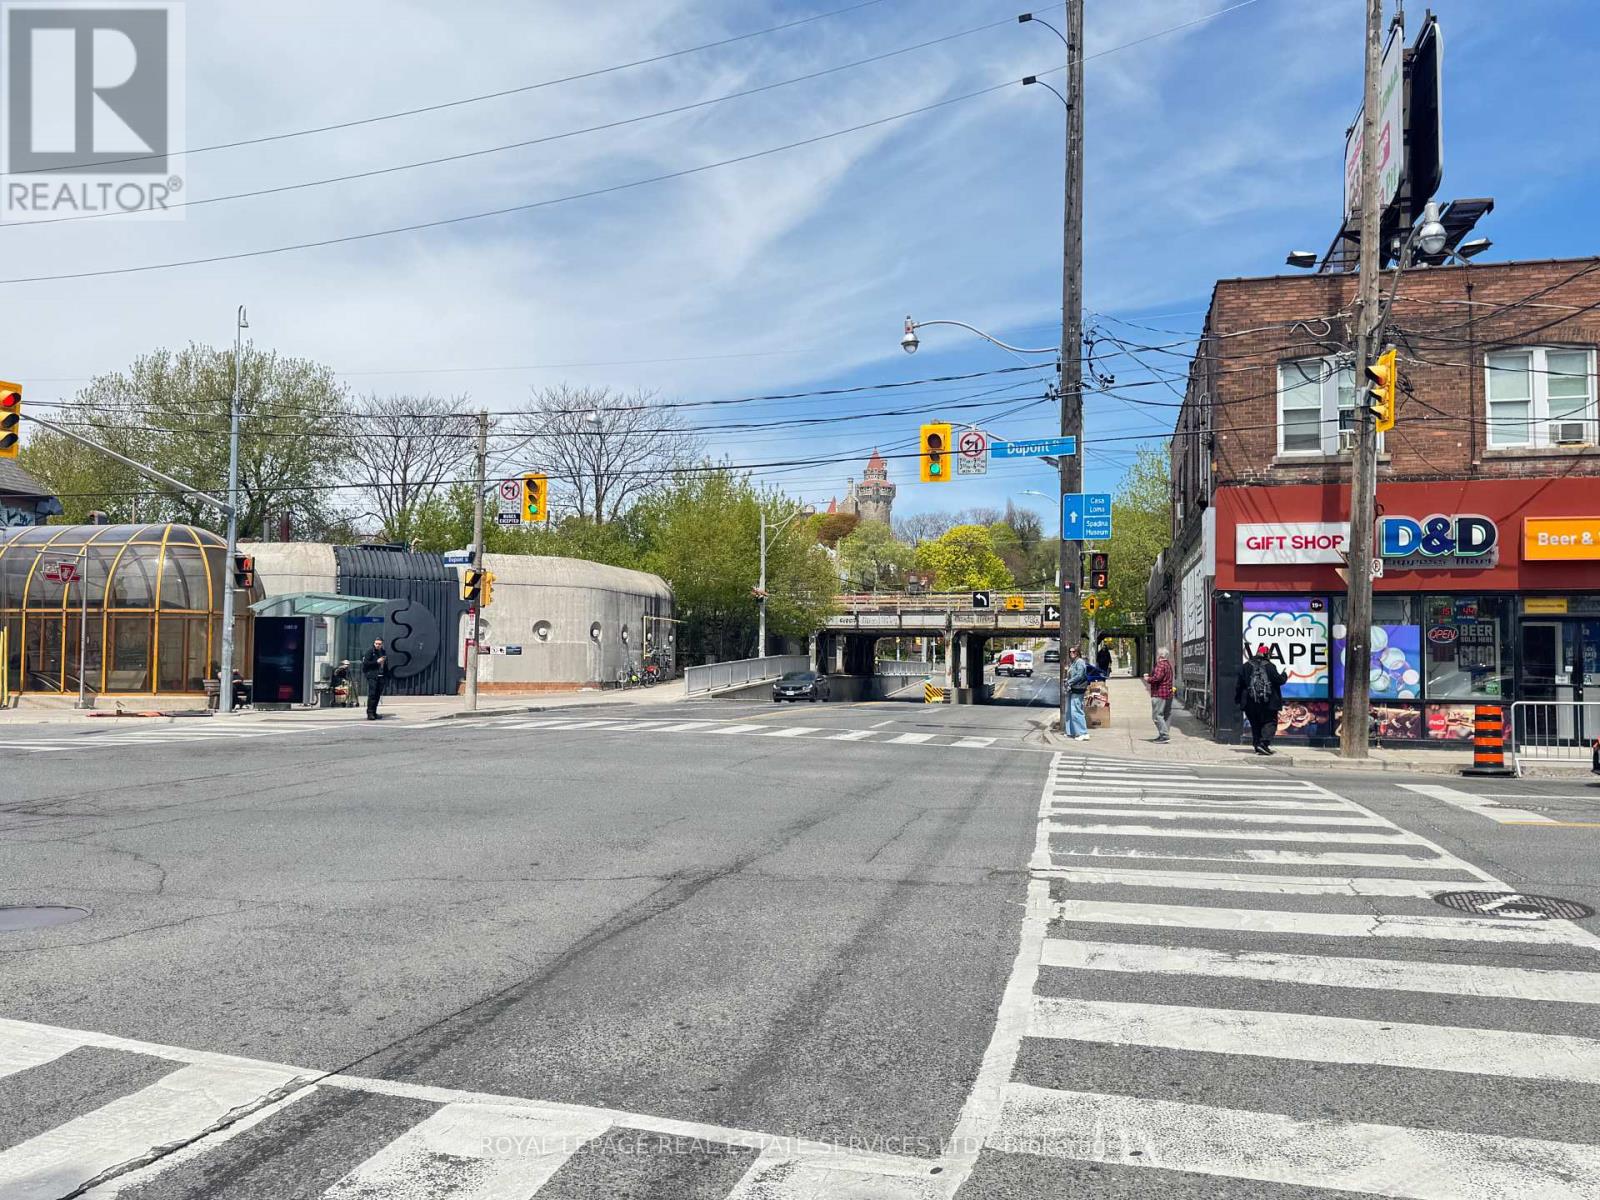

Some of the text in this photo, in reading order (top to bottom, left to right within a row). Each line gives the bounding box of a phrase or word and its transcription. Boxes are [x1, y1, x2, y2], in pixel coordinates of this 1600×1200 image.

[1007, 441, 1050, 456] Dupont
[1086, 520, 1109, 528] Spadina
[1246, 535, 1345, 550] GIFT SHOP
[1381, 517, 1496, 557] D&D
[1537, 531, 1594, 546] Beer &
[1097, 574, 1105, 588] 2
[1257, 627, 1314, 637] DUPONT
[1430, 629, 1456, 640] OPEN
[1460, 624, 1493, 637] BEER
[1244, 642, 1327, 666] VAPE
